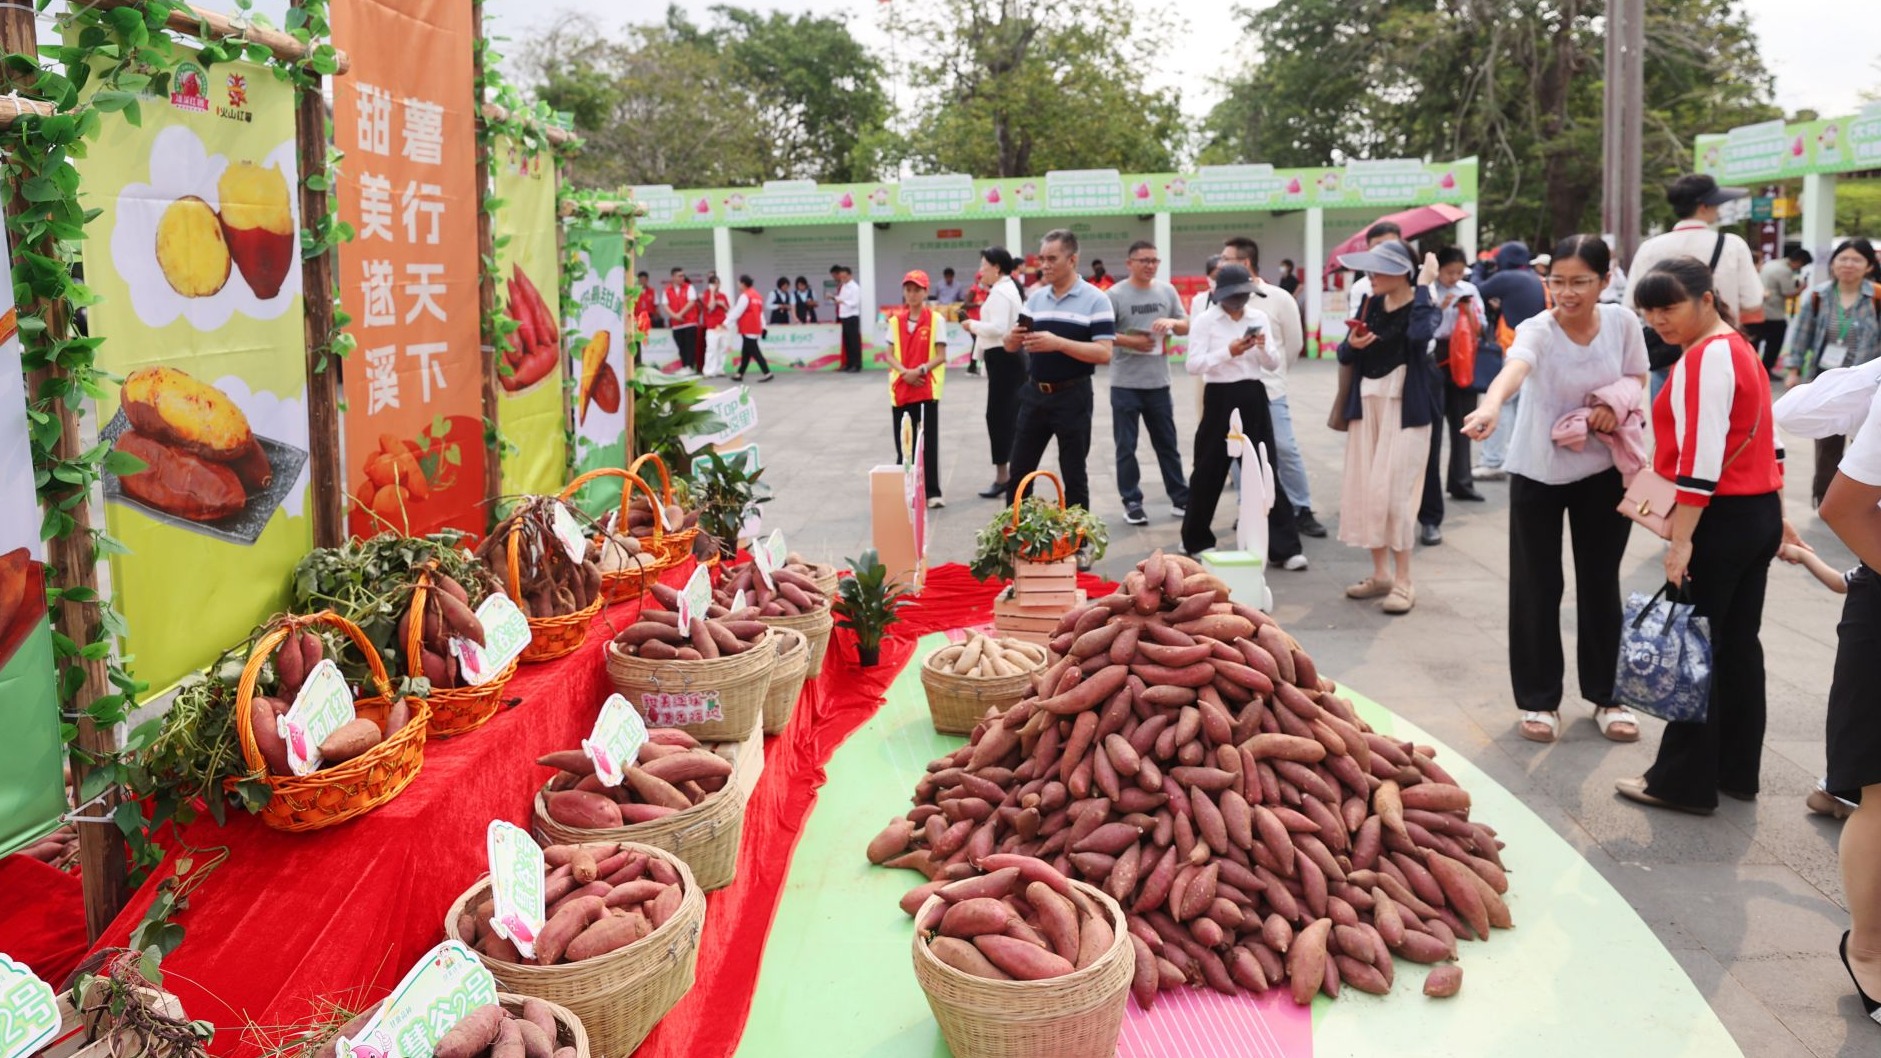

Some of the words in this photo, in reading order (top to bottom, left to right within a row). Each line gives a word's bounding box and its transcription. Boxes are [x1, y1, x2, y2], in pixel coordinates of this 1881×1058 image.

[355, 81, 400, 417] 甜美遂溪
[401, 97, 448, 403] 薯行天下
[1131, 303, 1159, 315] PUMA
